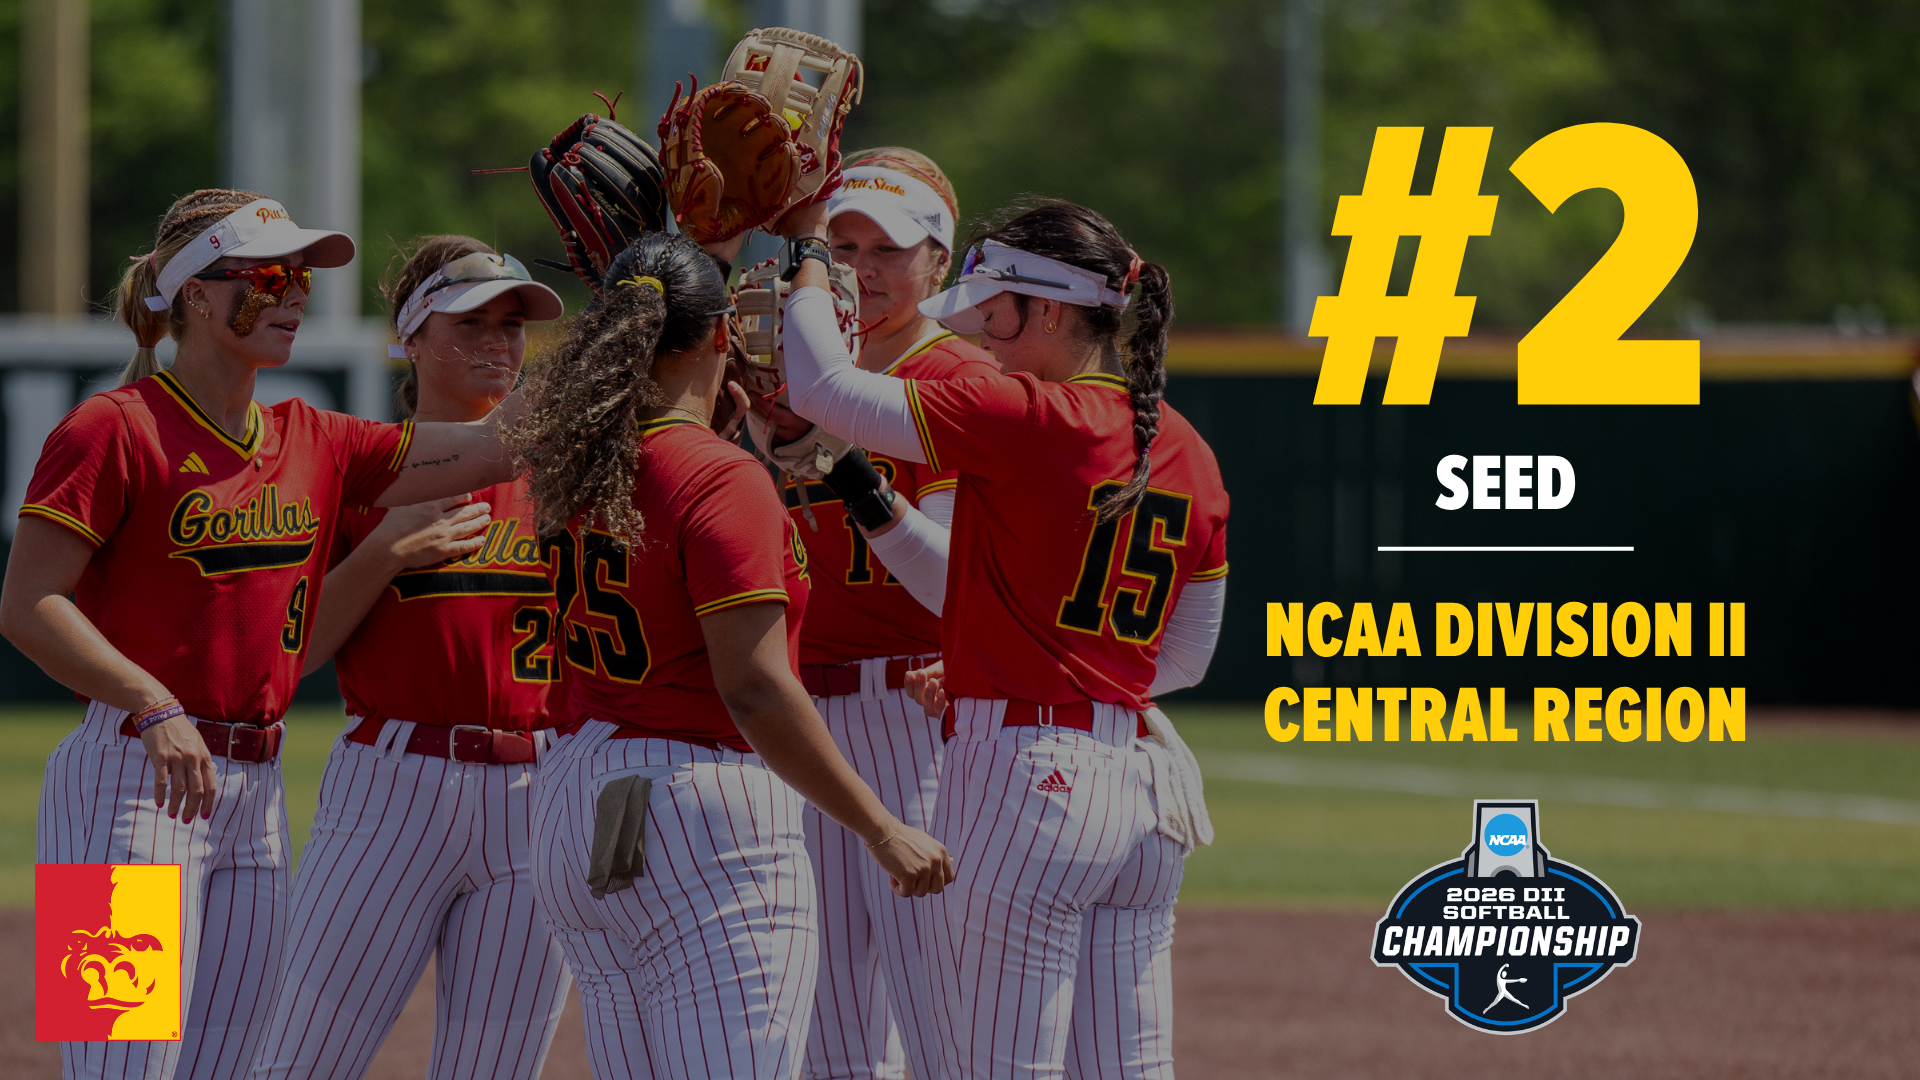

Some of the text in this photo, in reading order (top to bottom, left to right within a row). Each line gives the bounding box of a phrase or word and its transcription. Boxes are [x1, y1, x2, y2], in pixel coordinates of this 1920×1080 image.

[842, 177, 905, 196] Pitt State
[256, 207, 281, 225] Pitt
[209, 235, 221, 250] 9
[168, 483, 321, 547] Gorillas
[1055, 479, 1193, 646] 15
[280, 575, 309, 654] 9
[1037, 783, 1072, 793] adidas
